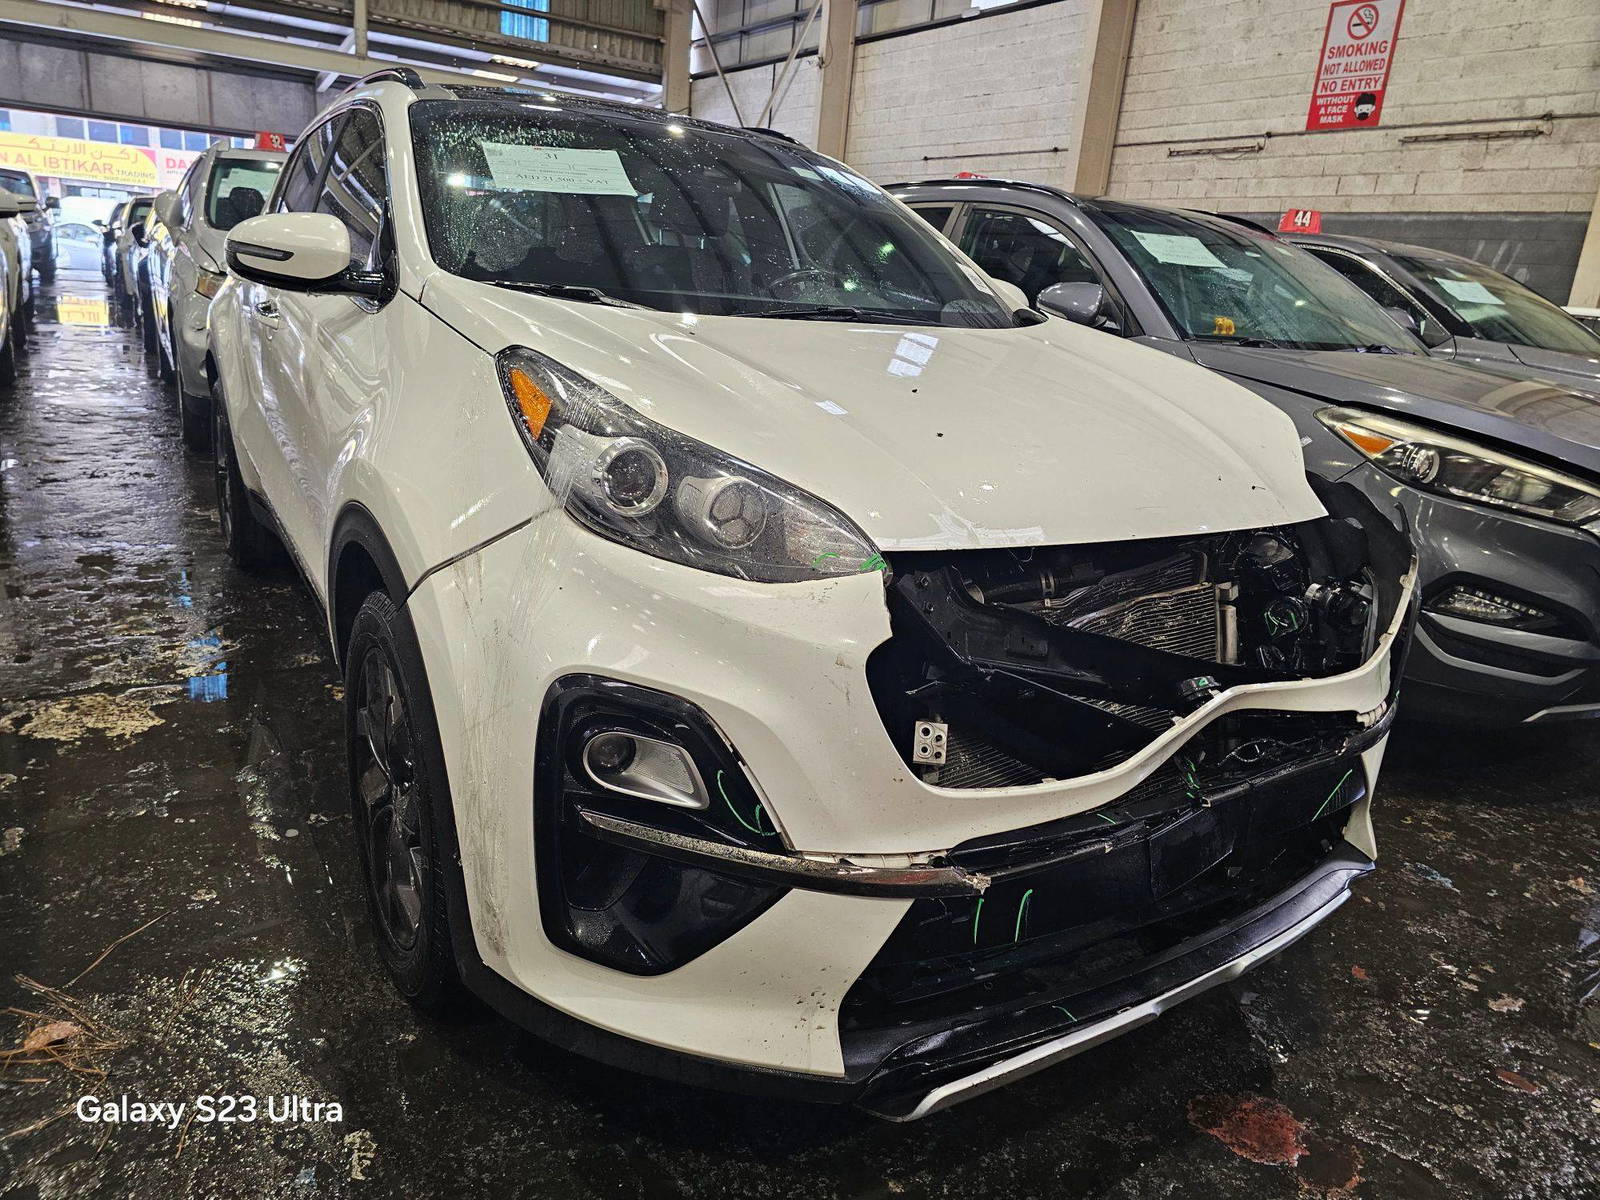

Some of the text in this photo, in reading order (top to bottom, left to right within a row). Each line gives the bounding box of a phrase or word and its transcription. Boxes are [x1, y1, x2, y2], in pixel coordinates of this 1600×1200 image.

[1328, 40, 1388, 59] SMOKING
[1323, 58, 1386, 76] NOT ALLOWED
[1320, 76, 1381, 93] NO ENTRY
[1316, 95, 1355, 105] WITHOUT
[1319, 105, 1348, 114] A FACE
[1320, 115, 1344, 123] MASK
[15, 153, 38, 167] AL
[43, 155, 114, 175] IBTIKAR
[116, 168, 156, 180] TRADING
[1294, 210, 1312, 227] 44
